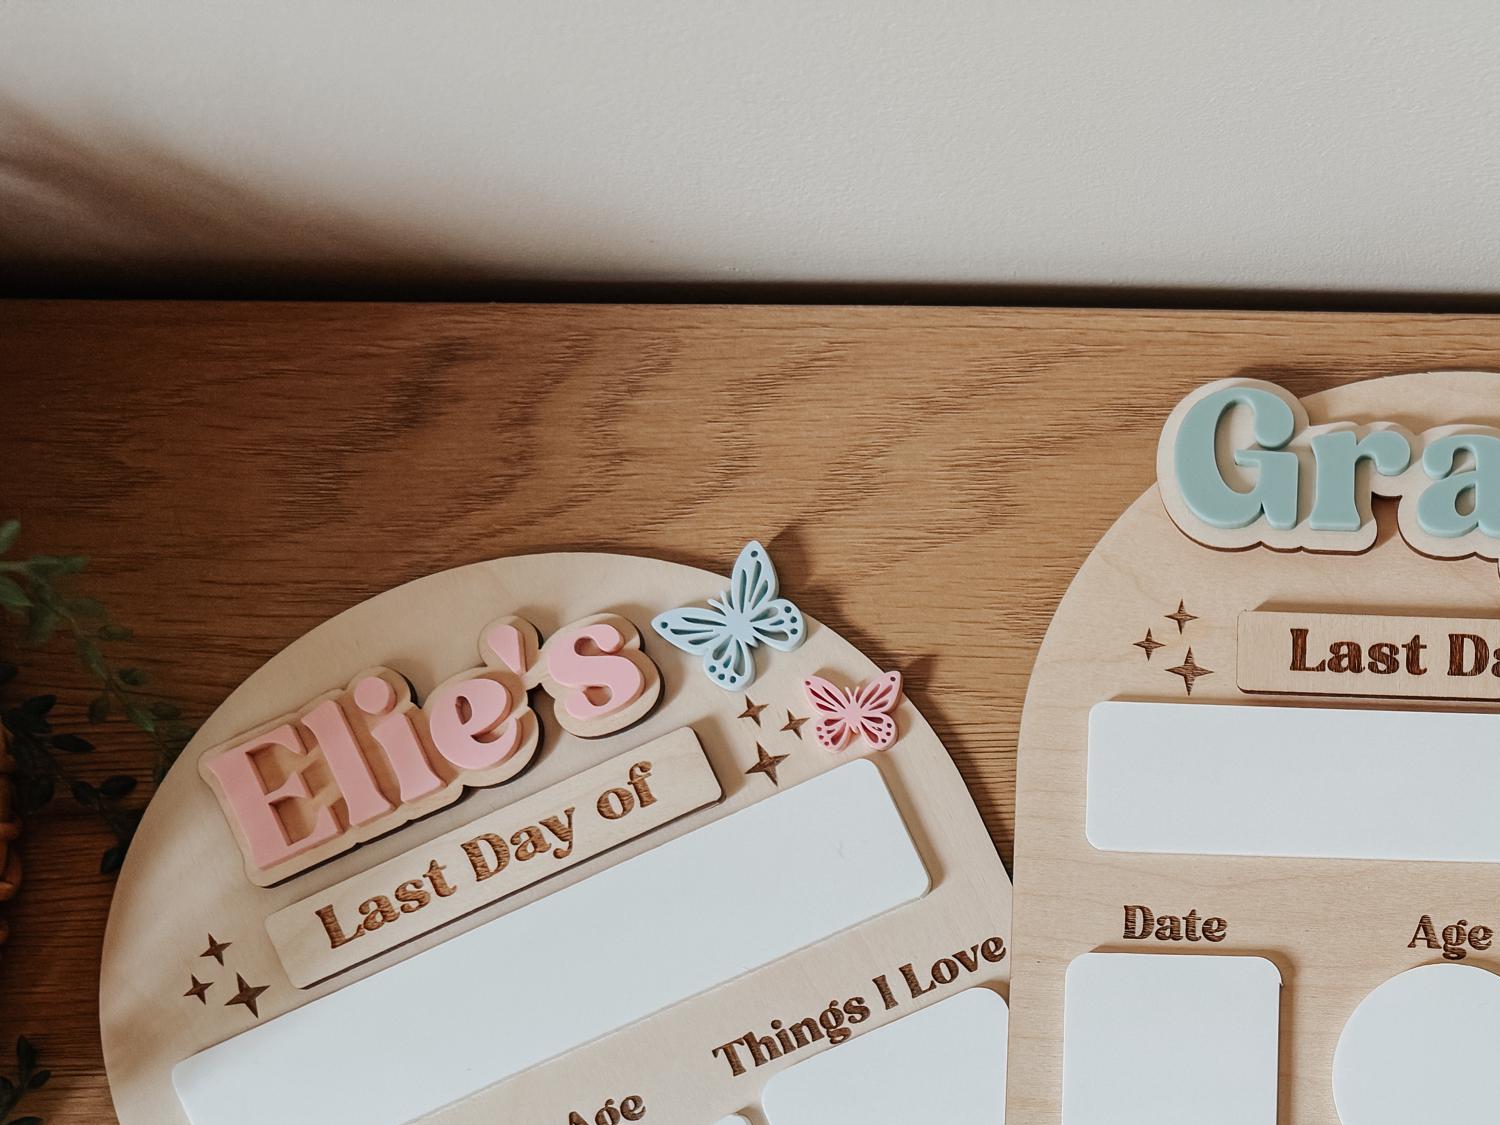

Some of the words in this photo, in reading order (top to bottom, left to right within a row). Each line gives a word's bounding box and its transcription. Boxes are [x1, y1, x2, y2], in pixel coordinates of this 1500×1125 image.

[1289, 627, 1428, 677] Last
[205, 623, 646, 871] Elie's
[314, 859, 459, 950] Last
[460, 806, 576, 883] Day
[596, 760, 659, 821] of
[1122, 904, 1228, 943] Date
[1408, 914, 1494, 960] Age
[712, 996, 871, 1077] Things
[872, 974, 899, 1010] I
[899, 936, 1007, 999] Love
